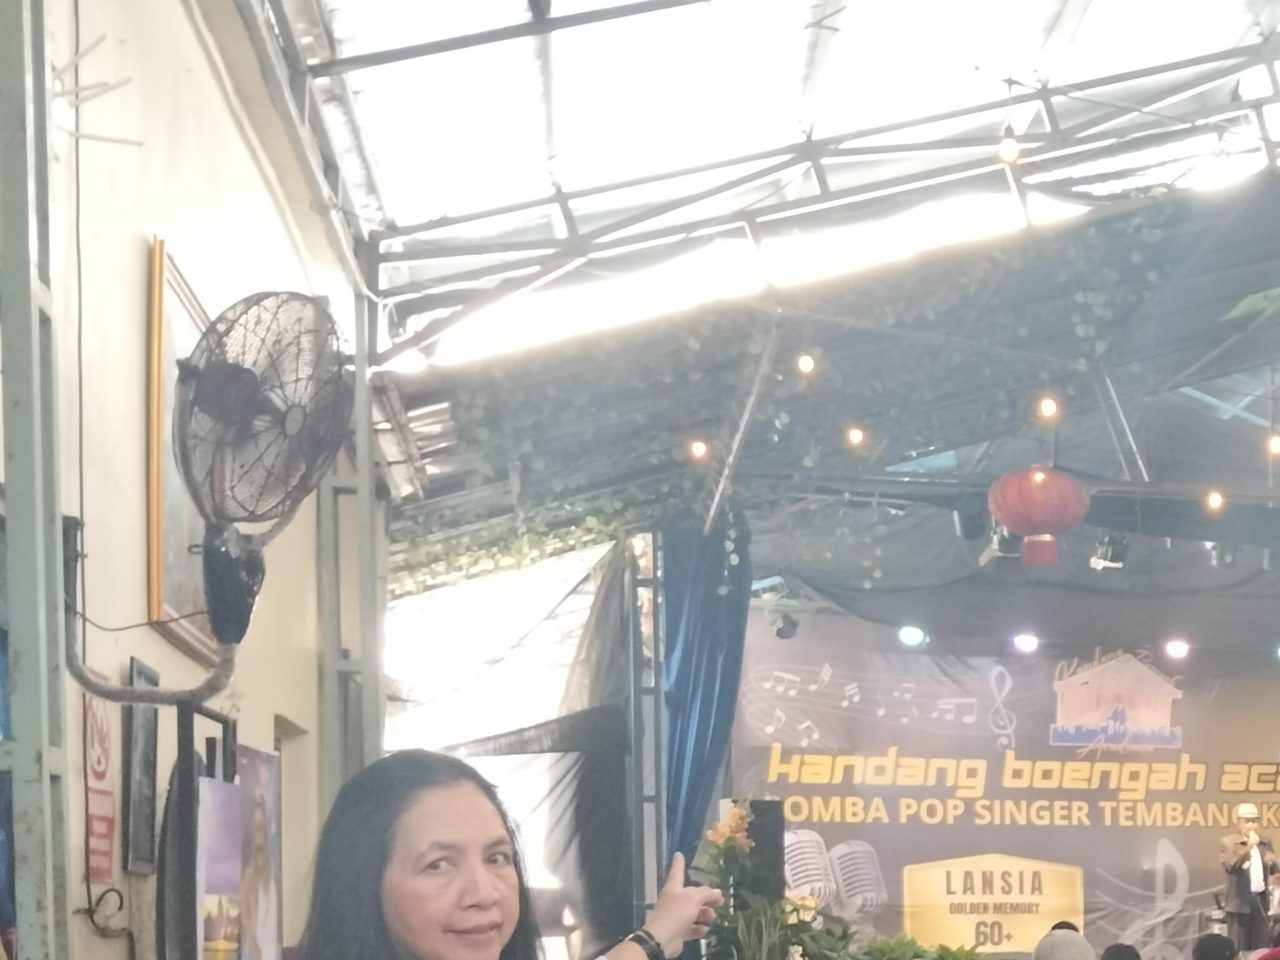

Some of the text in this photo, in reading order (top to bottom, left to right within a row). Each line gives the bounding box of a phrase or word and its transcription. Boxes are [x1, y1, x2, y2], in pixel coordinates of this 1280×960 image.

[767, 742, 988, 799] kandang
[1002, 749, 1207, 800] boengah
[783, 796, 890, 824] OMBA
[899, 798, 966, 825] POP
[974, 799, 1092, 827] SINGER
[945, 870, 1044, 896] LANSIA
[949, 902, 1040, 915] GOLDEN MEMORY
[975, 921, 1014, 946] 60+
